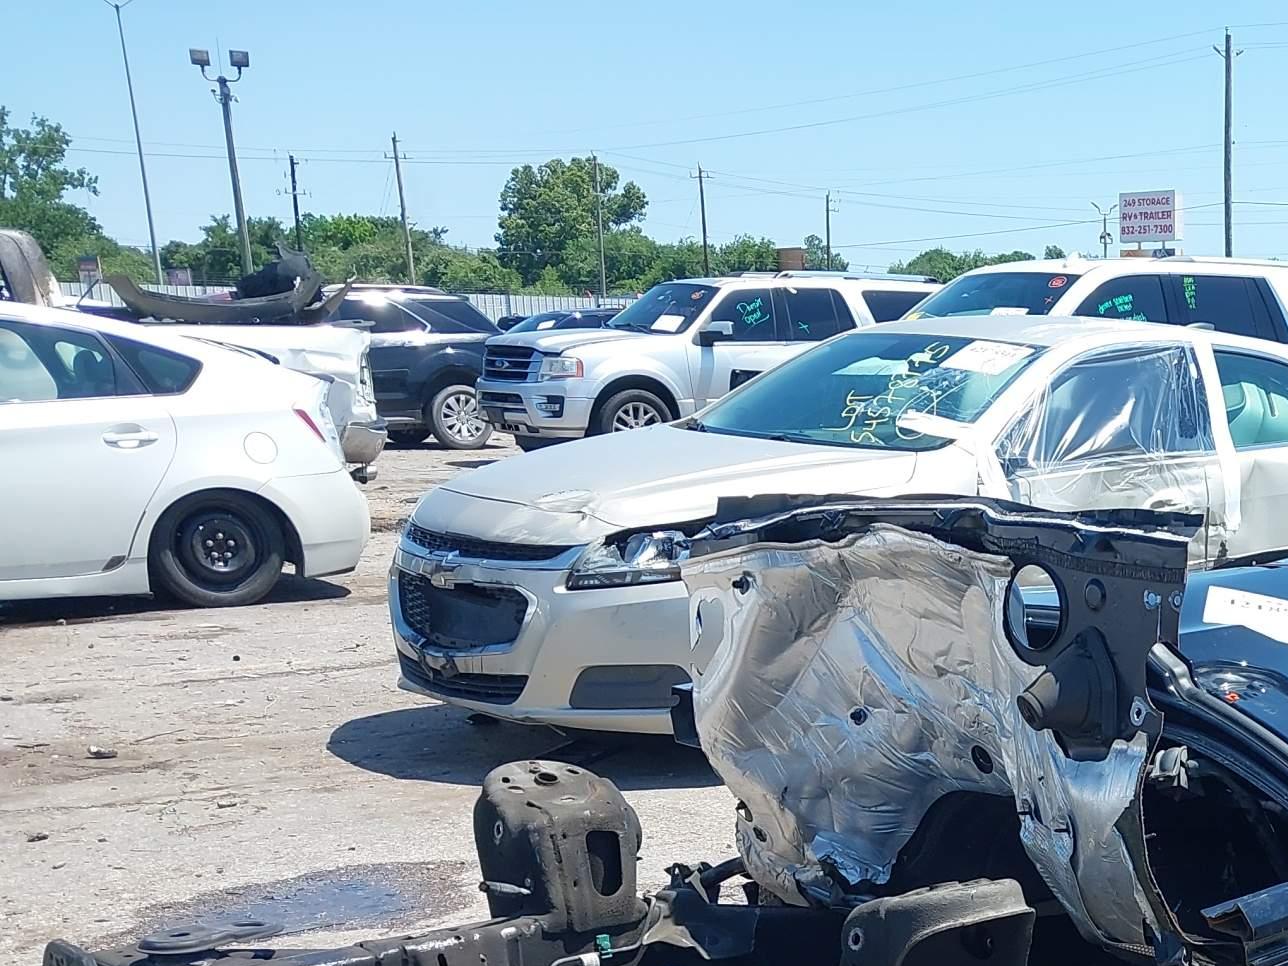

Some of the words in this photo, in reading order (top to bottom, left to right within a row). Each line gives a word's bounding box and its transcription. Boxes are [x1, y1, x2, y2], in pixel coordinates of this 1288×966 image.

[1123, 199, 1136, 207] 249
[1137, 197, 1170, 206] STORAGE
[1122, 212, 1133, 221] RV
[1139, 211, 1171, 220] TRAILER
[1121, 224, 1172, 234] 832-251-7300
